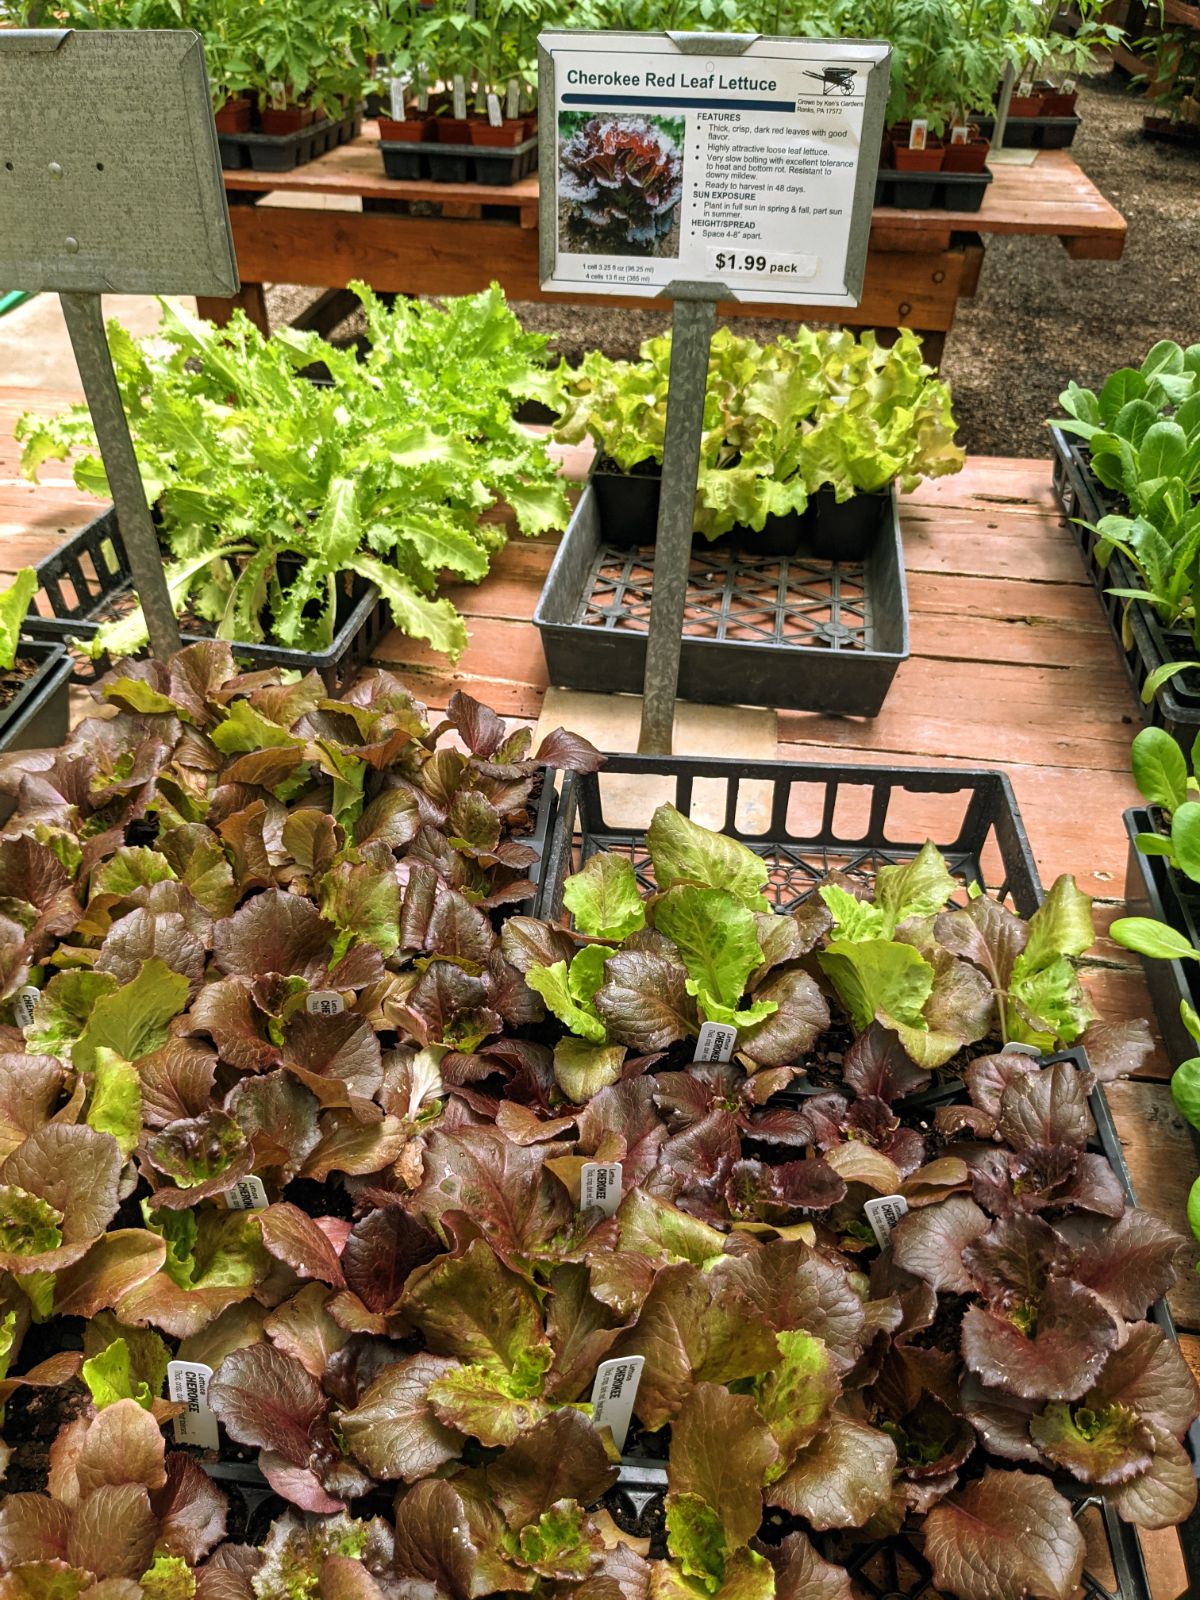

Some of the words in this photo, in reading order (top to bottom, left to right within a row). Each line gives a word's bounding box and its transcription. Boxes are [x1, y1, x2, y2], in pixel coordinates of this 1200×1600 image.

[568, 70, 640, 86] Cherokee
[646, 72, 675, 88] Red
[681, 74, 714, 88] Leaf
[719, 74, 776, 91] Lettuce
[697, 112, 741, 122] FEATURES
[709, 124, 730, 132] Thick,
[732, 126, 752, 134] crisp,
[786, 128, 810, 136] leaves
[812, 128, 826, 136] with
[828, 130, 848, 138] good
[708, 144, 730, 153] Highly
[803, 148, 830, 156] lettuce.
[707, 154, 724, 163] Very
[744, 156, 768, 165] bolting
[786, 158, 819, 166] excellent
[820, 159, 854, 168] tolerance
[706, 172, 729, 180] downy
[748, 164, 773, 172] bottom
[789, 166, 823, 175] Resistant
[705, 181, 729, 190] Ready
[739, 182, 765, 191] harvest
[786, 185, 806, 194] days.
[693, 190, 710, 198] SUN
[712, 191, 756, 200] EXPOSURE
[704, 201, 722, 209] Plant
[768, 204, 789, 214] spring
[791, 205, 796, 214] &
[798, 206, 811, 214] fall,
[692, 219, 756, 229] HEIGHT/SPREAD
[702, 230, 725, 238] Space
[715, 252, 766, 271] $1.99
[770, 263, 797, 274] pack
[724, 1033, 734, 1050] Lettuce
[249, 1182, 258, 1199] Lettuce
[596, 1169, 607, 1199] CHEROKEE
[881, 1204, 898, 1228] CHEROK
[626, 1362, 638, 1381] Lettuce
[609, 1365, 627, 1399] CHEROKEE
[186, 1371, 199, 1413] CHEROKEE
